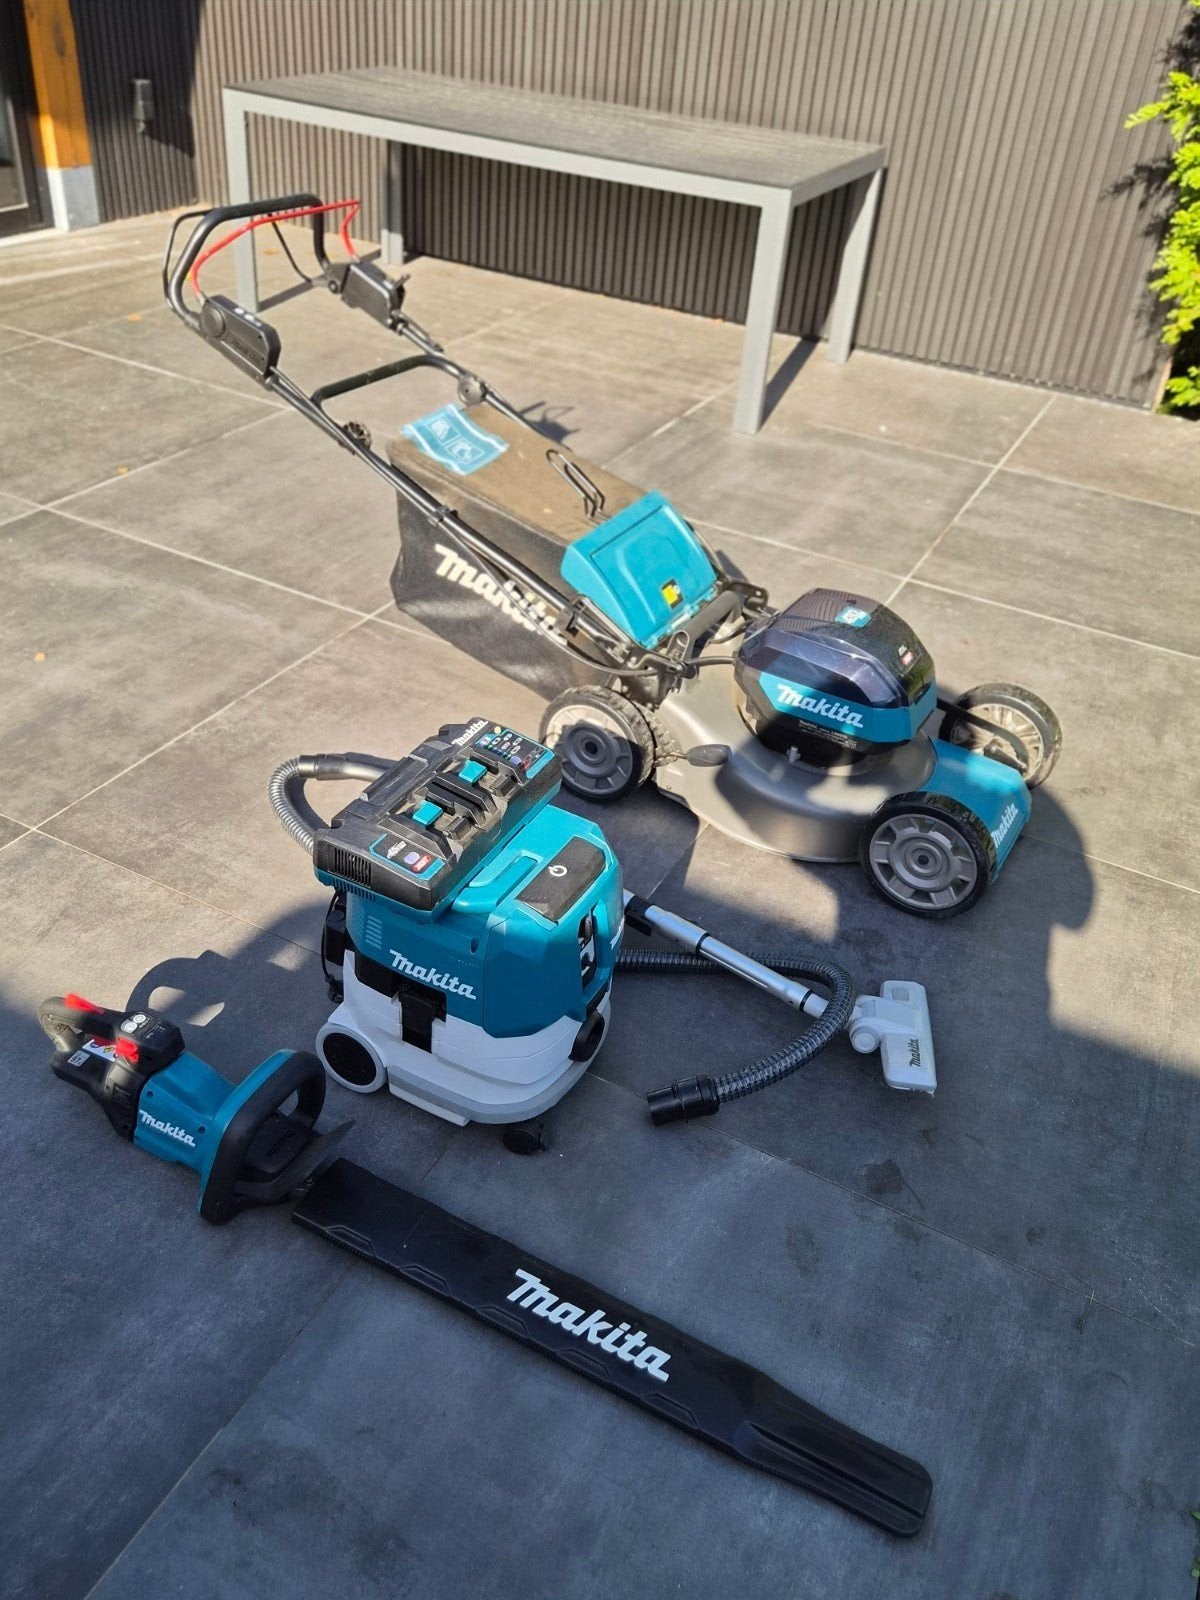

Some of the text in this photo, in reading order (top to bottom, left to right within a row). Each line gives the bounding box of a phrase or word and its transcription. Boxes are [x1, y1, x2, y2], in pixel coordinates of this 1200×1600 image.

[777, 683, 863, 728] makita
[451, 720, 488, 746] makita
[991, 803, 1018, 848] makita
[388, 948, 476, 1000] makita
[140, 1110, 195, 1147] makita
[507, 1268, 671, 1382] makita
